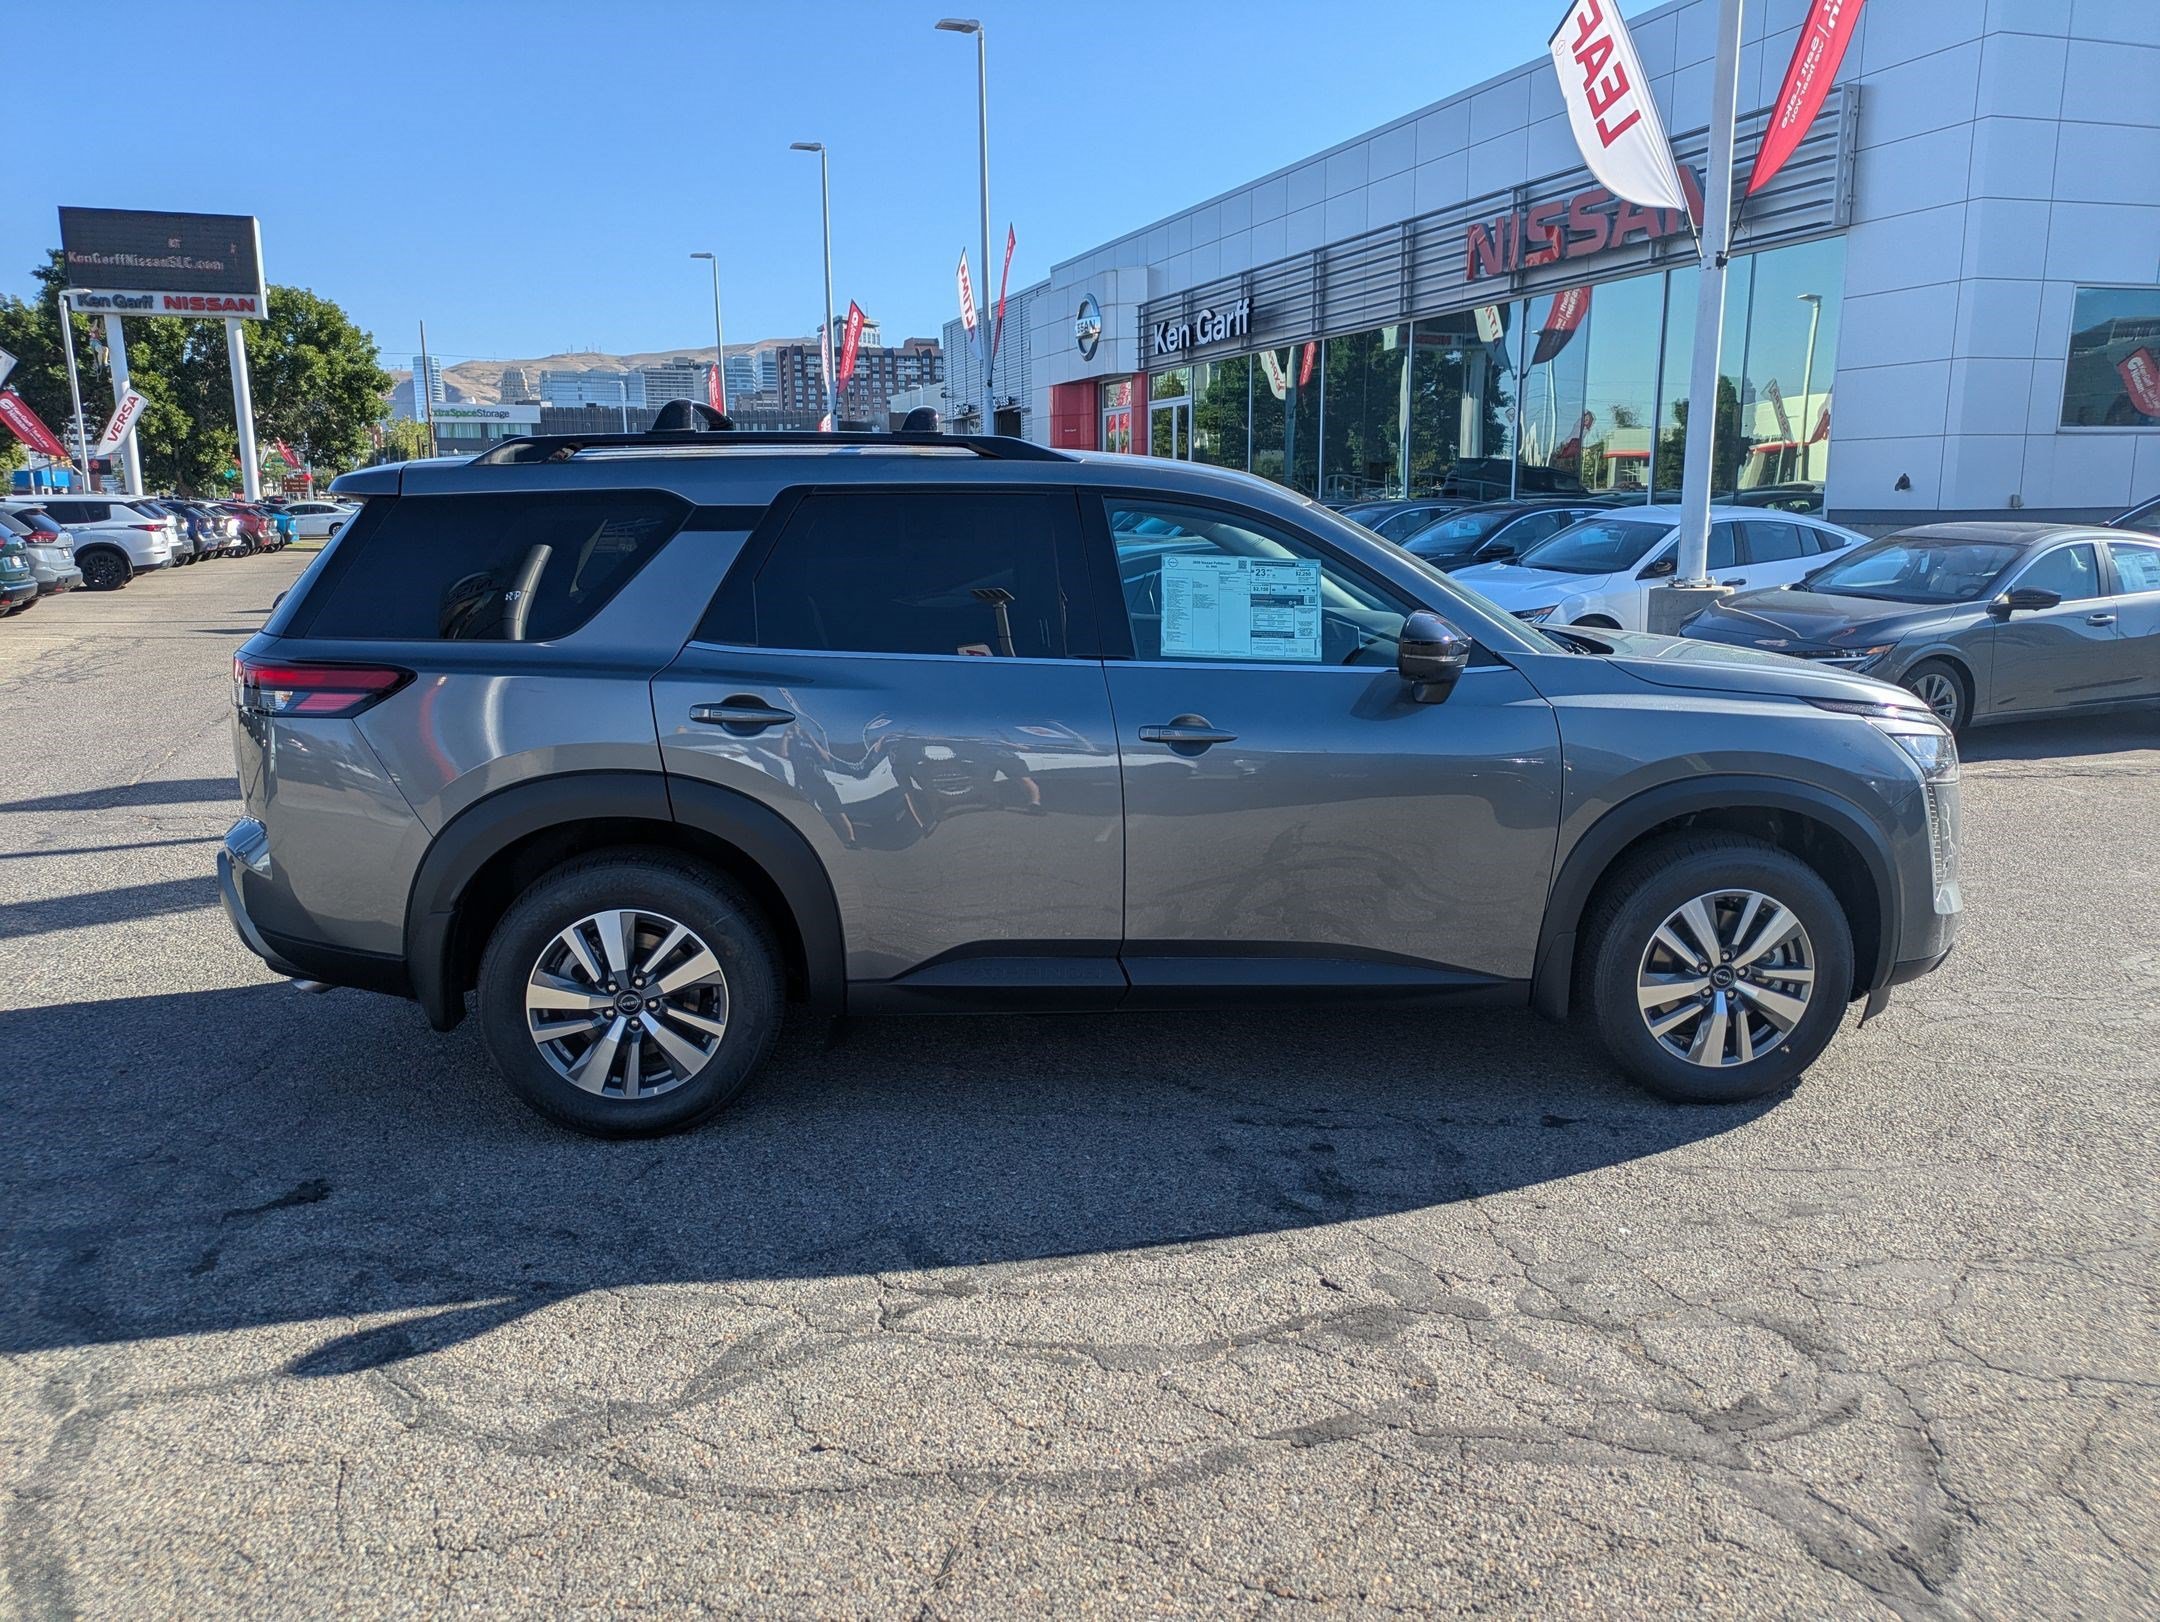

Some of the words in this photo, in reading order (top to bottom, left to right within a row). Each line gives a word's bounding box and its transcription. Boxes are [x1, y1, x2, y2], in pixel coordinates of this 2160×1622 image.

[77, 293, 111, 309] Ken
[112, 294, 154, 310] Garff
[163, 295, 256, 313] NISSAN
[1153, 320, 1191, 355] Ken
[1196, 297, 1251, 345] Garff
[107, 395, 140, 443] VERSA
[432, 408, 509, 419] xtraSpaceStorage
[1255, 568, 1266, 577] 23
